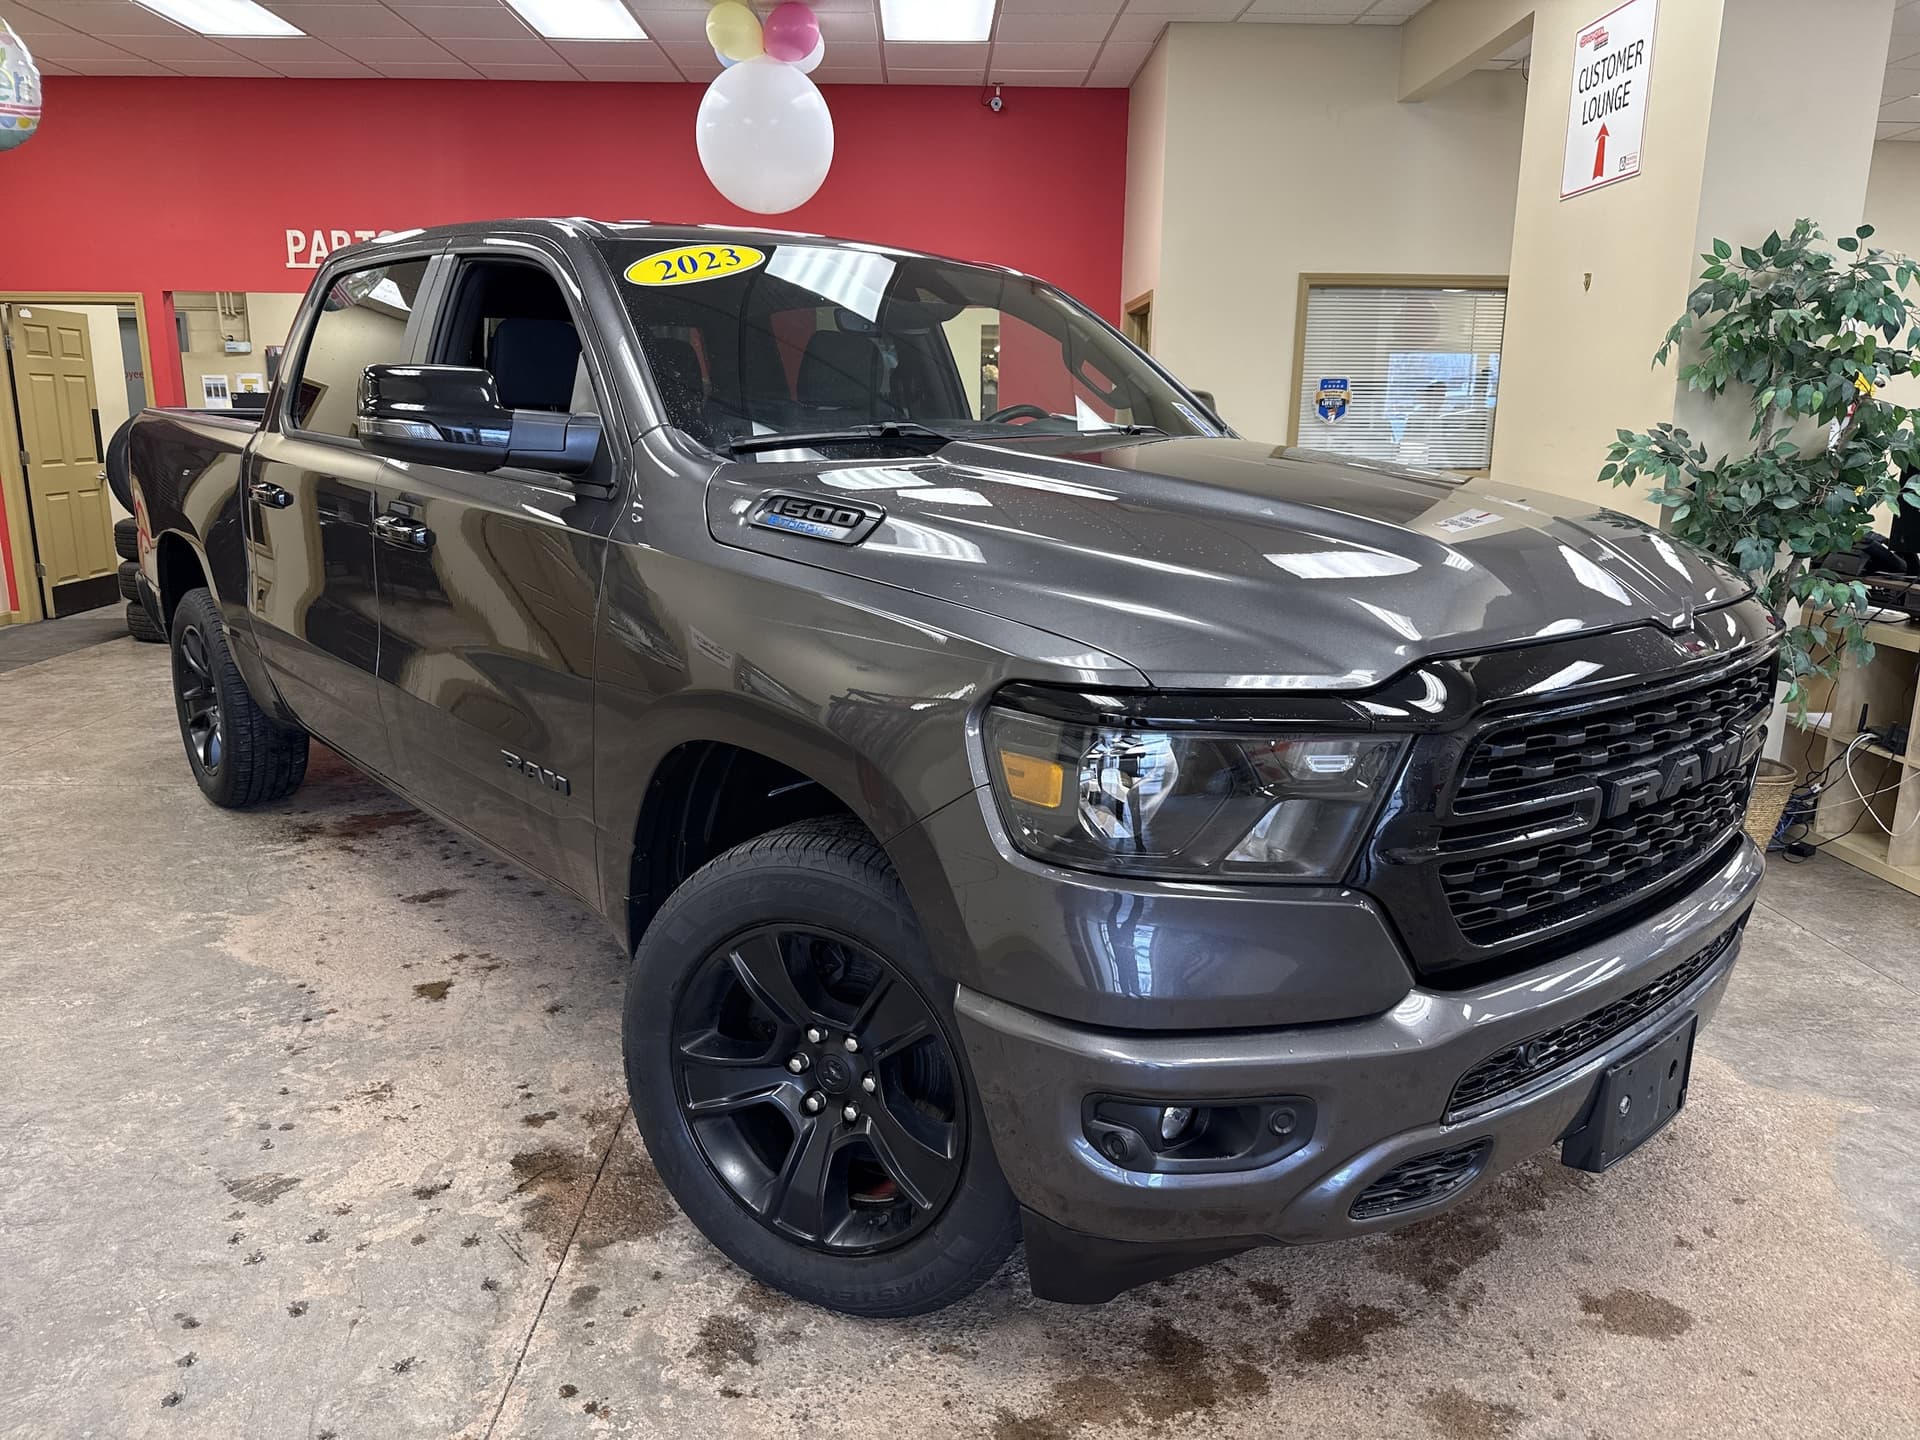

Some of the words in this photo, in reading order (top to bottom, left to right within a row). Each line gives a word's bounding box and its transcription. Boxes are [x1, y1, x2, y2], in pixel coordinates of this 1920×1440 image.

[1578, 39, 1644, 94] CUSTOMER
[1582, 80, 1631, 126] LOUNGE
[286, 229, 395, 265] PAR
[654, 248, 741, 281] 2023
[767, 498, 860, 528] 1500
[501, 748, 571, 796] RAM
[1607, 735, 1741, 819] RAM
